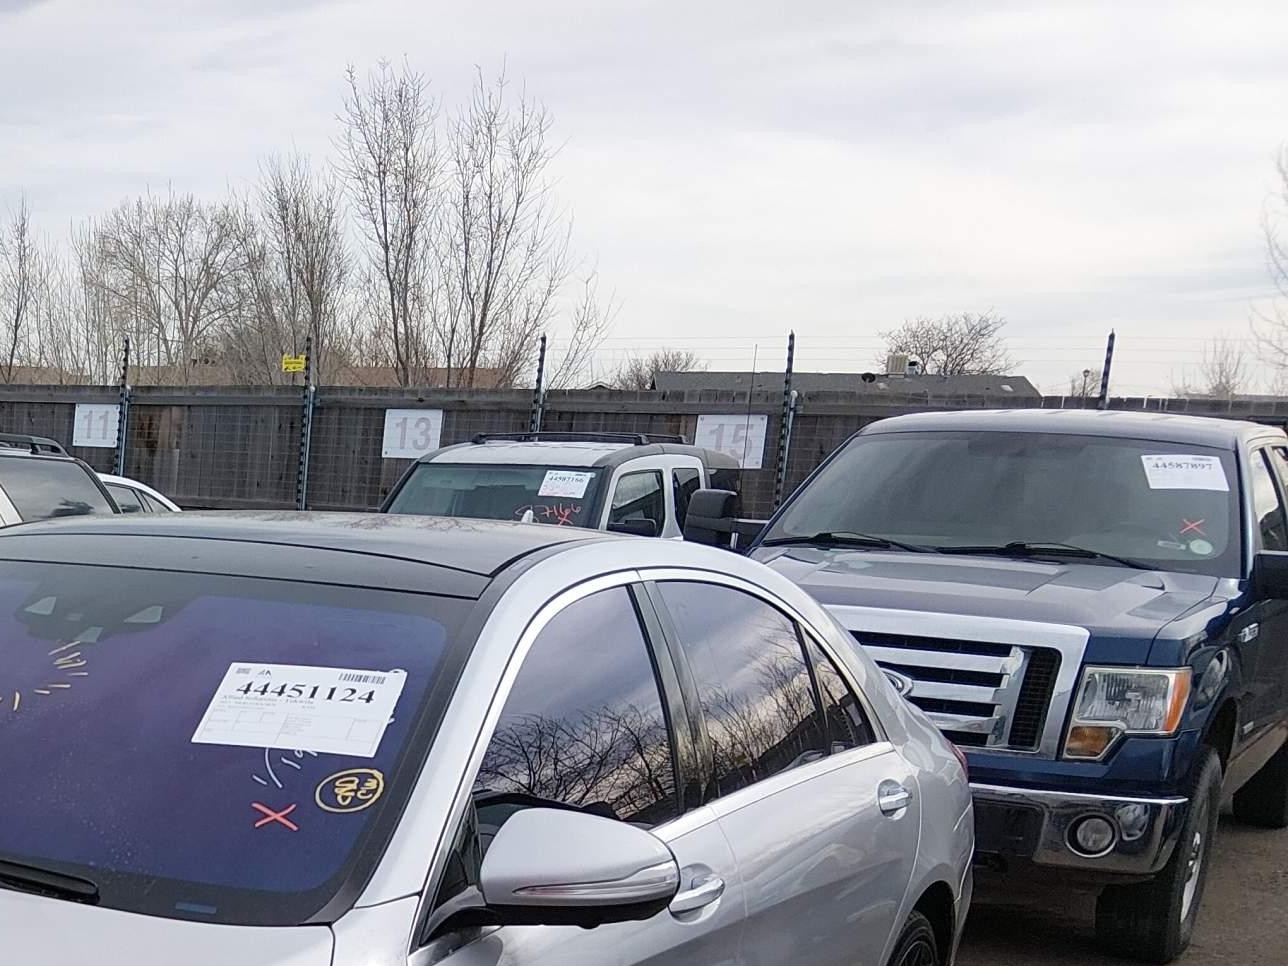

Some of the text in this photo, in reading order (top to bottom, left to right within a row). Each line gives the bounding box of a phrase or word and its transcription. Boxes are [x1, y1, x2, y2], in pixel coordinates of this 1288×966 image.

[83, 410, 109, 440] 11
[395, 416, 433, 450] 13
[709, 423, 754, 461] 15
[236, 680, 376, 704] 44451124
